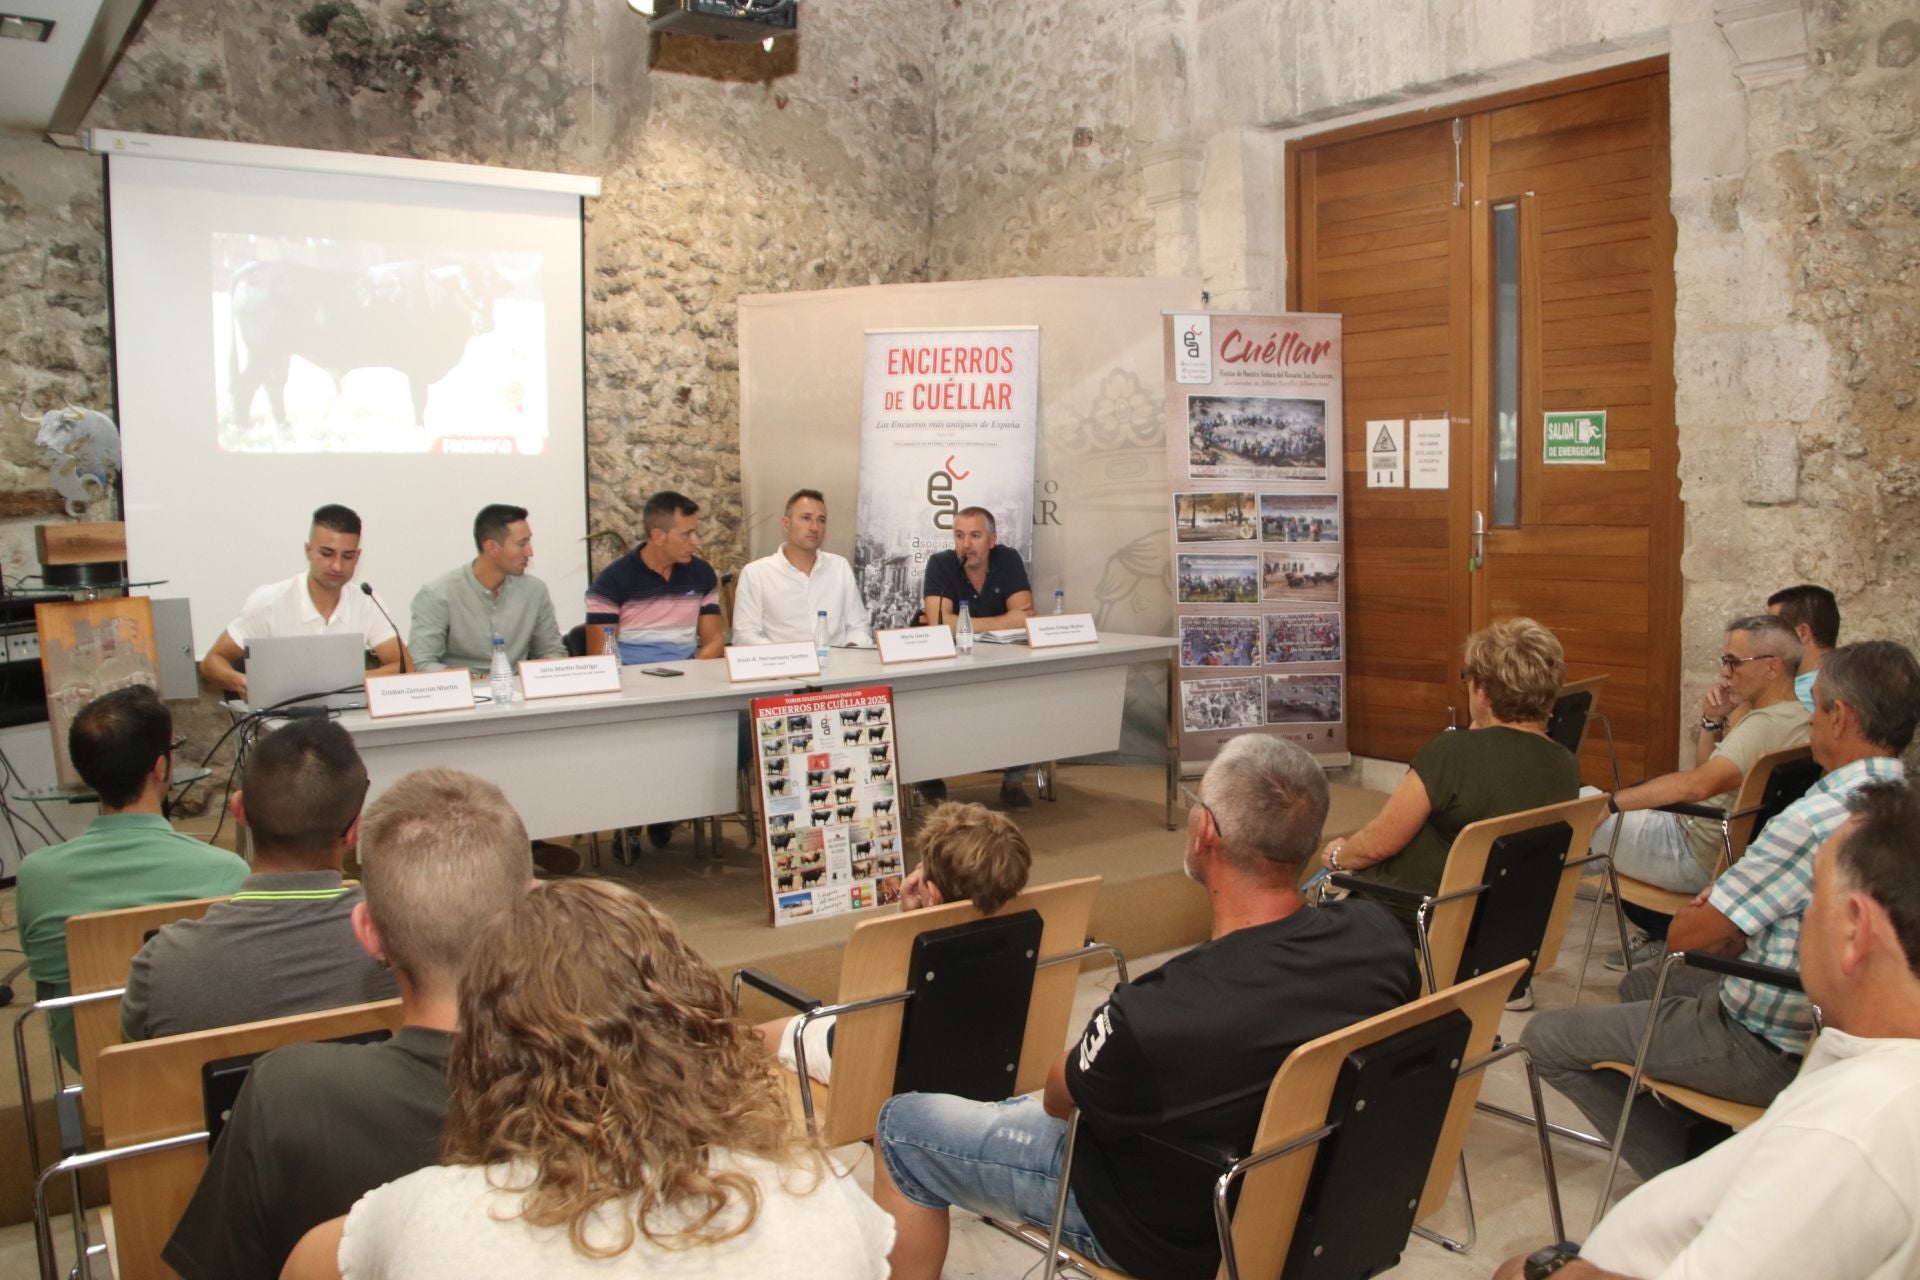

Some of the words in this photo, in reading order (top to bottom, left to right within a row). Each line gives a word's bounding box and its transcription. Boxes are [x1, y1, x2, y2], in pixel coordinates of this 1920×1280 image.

[1219, 328, 1331, 367] Cuéllar
[887, 346, 1014, 375] ENCIERROS
[884, 391, 904, 411] DE
[912, 378, 1013, 411] CUÉLLAR
[891, 420, 926, 429] Encierros
[946, 420, 978, 431] antiguos
[980, 419, 988, 429] de
[991, 419, 1021, 431] España
[1548, 422, 1573, 440] SALIDA
[1548, 446, 1557, 457] DE
[1558, 446, 1600, 457] EMERGENCIA
[758, 703, 812, 717] ENCIERROS
[813, 702, 826, 711] DE
[827, 698, 866, 710] CUÉLLAR
[867, 695, 887, 705] 2025
